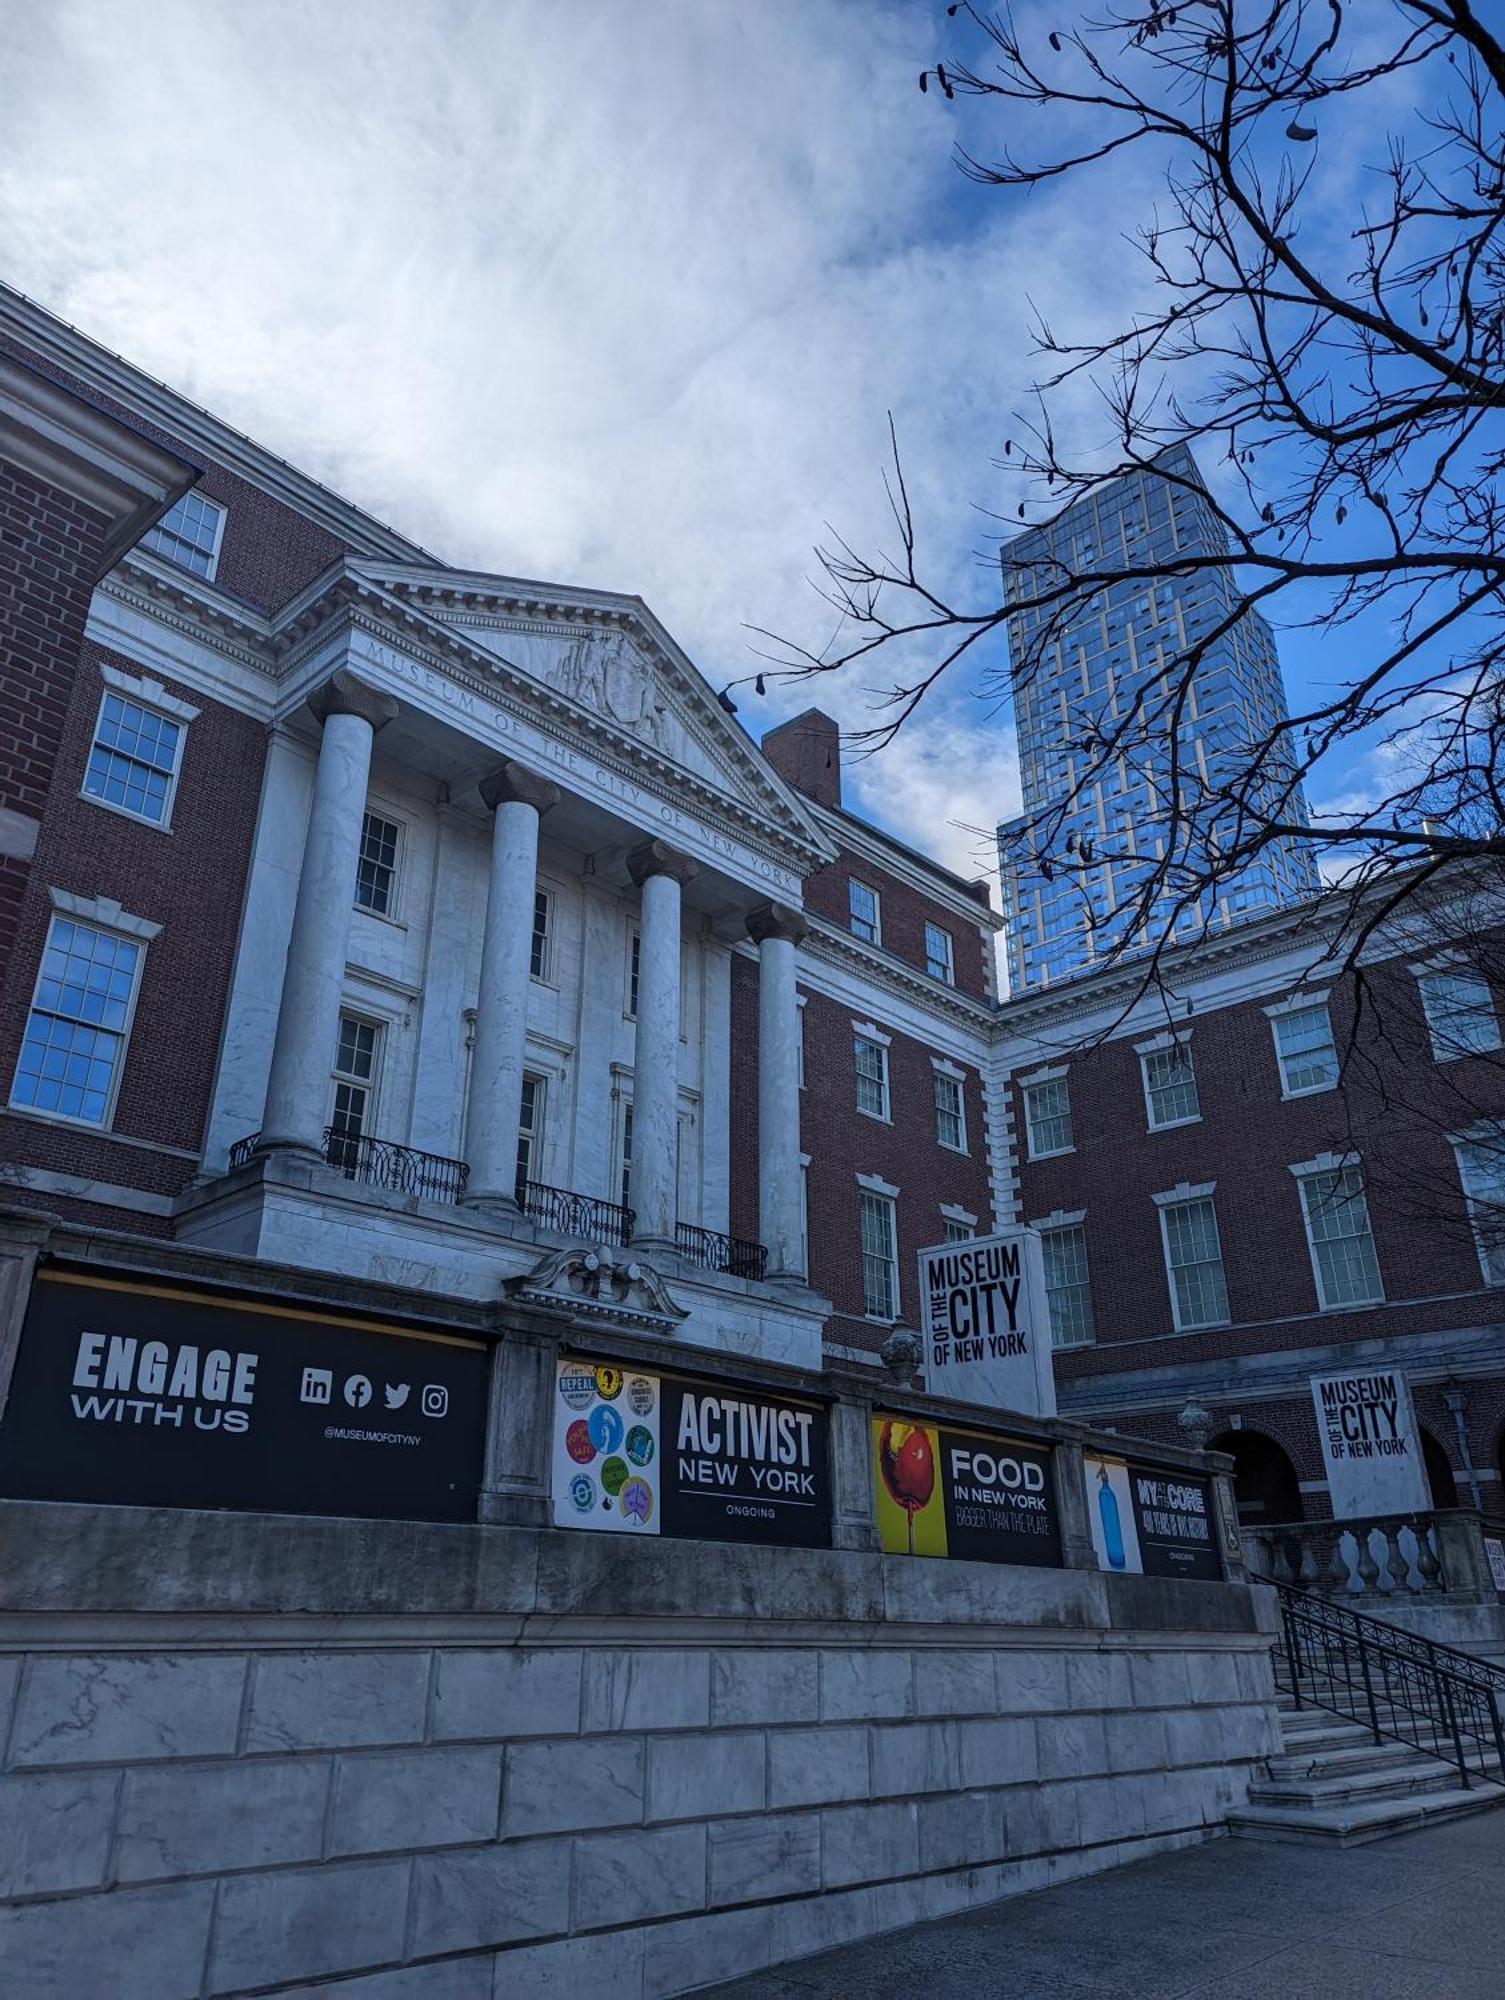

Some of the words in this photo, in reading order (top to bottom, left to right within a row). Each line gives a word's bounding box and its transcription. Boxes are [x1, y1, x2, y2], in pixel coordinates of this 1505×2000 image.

[367, 641, 475, 713] MUSEUM
[495, 713, 523, 737] OF
[544, 739, 577, 772] THE
[596, 770, 640, 801] CITY
[660, 806, 683, 825] OF
[700, 827, 737, 857] NEW
[751, 856, 793, 890] YORK
[928, 1243, 1021, 1292] MUSEUM
[930, 1291, 948, 1320] THE
[949, 1278, 1021, 1339] CITY
[932, 1323, 950, 1342] OF
[933, 1343, 951, 1366] OF
[954, 1338, 985, 1364] NEW
[988, 1332, 1028, 1358] YORK
[73, 1331, 259, 1405] ENGAGE
[561, 1377, 594, 1390] REPEAL
[1320, 1375, 1397, 1406] MUSEUM
[70, 1393, 184, 1428] WITH
[193, 1403, 251, 1433] US
[677, 1392, 813, 1467] ACTIVIST
[1325, 1407, 1341, 1426] THE
[1340, 1401, 1398, 1441] CITY
[324, 1426, 421, 1446] @MUSEUMOFCITYNY
[1328, 1427, 1343, 1442] OF
[1331, 1443, 1345, 1460] OF
[1348, 1441, 1374, 1458] NEW
[1375, 1438, 1408, 1457] YORK
[678, 1458, 739, 1486] NEW
[750, 1466, 816, 1496] YORK
[950, 1449, 1045, 1492] FOOD
[726, 1504, 776, 1520] ONGOING
[953, 1484, 969, 1501] IN
[972, 1487, 1006, 1505] NEW
[1008, 1492, 1047, 1511] YORK
[1136, 1478, 1158, 1507] NY
[1167, 1483, 1206, 1514] CORE
[955, 1504, 987, 1529] BIGGER
[986, 1508, 1010, 1531] THAN
[1008, 1511, 1027, 1534] THE
[1026, 1513, 1051, 1536] PLATE
